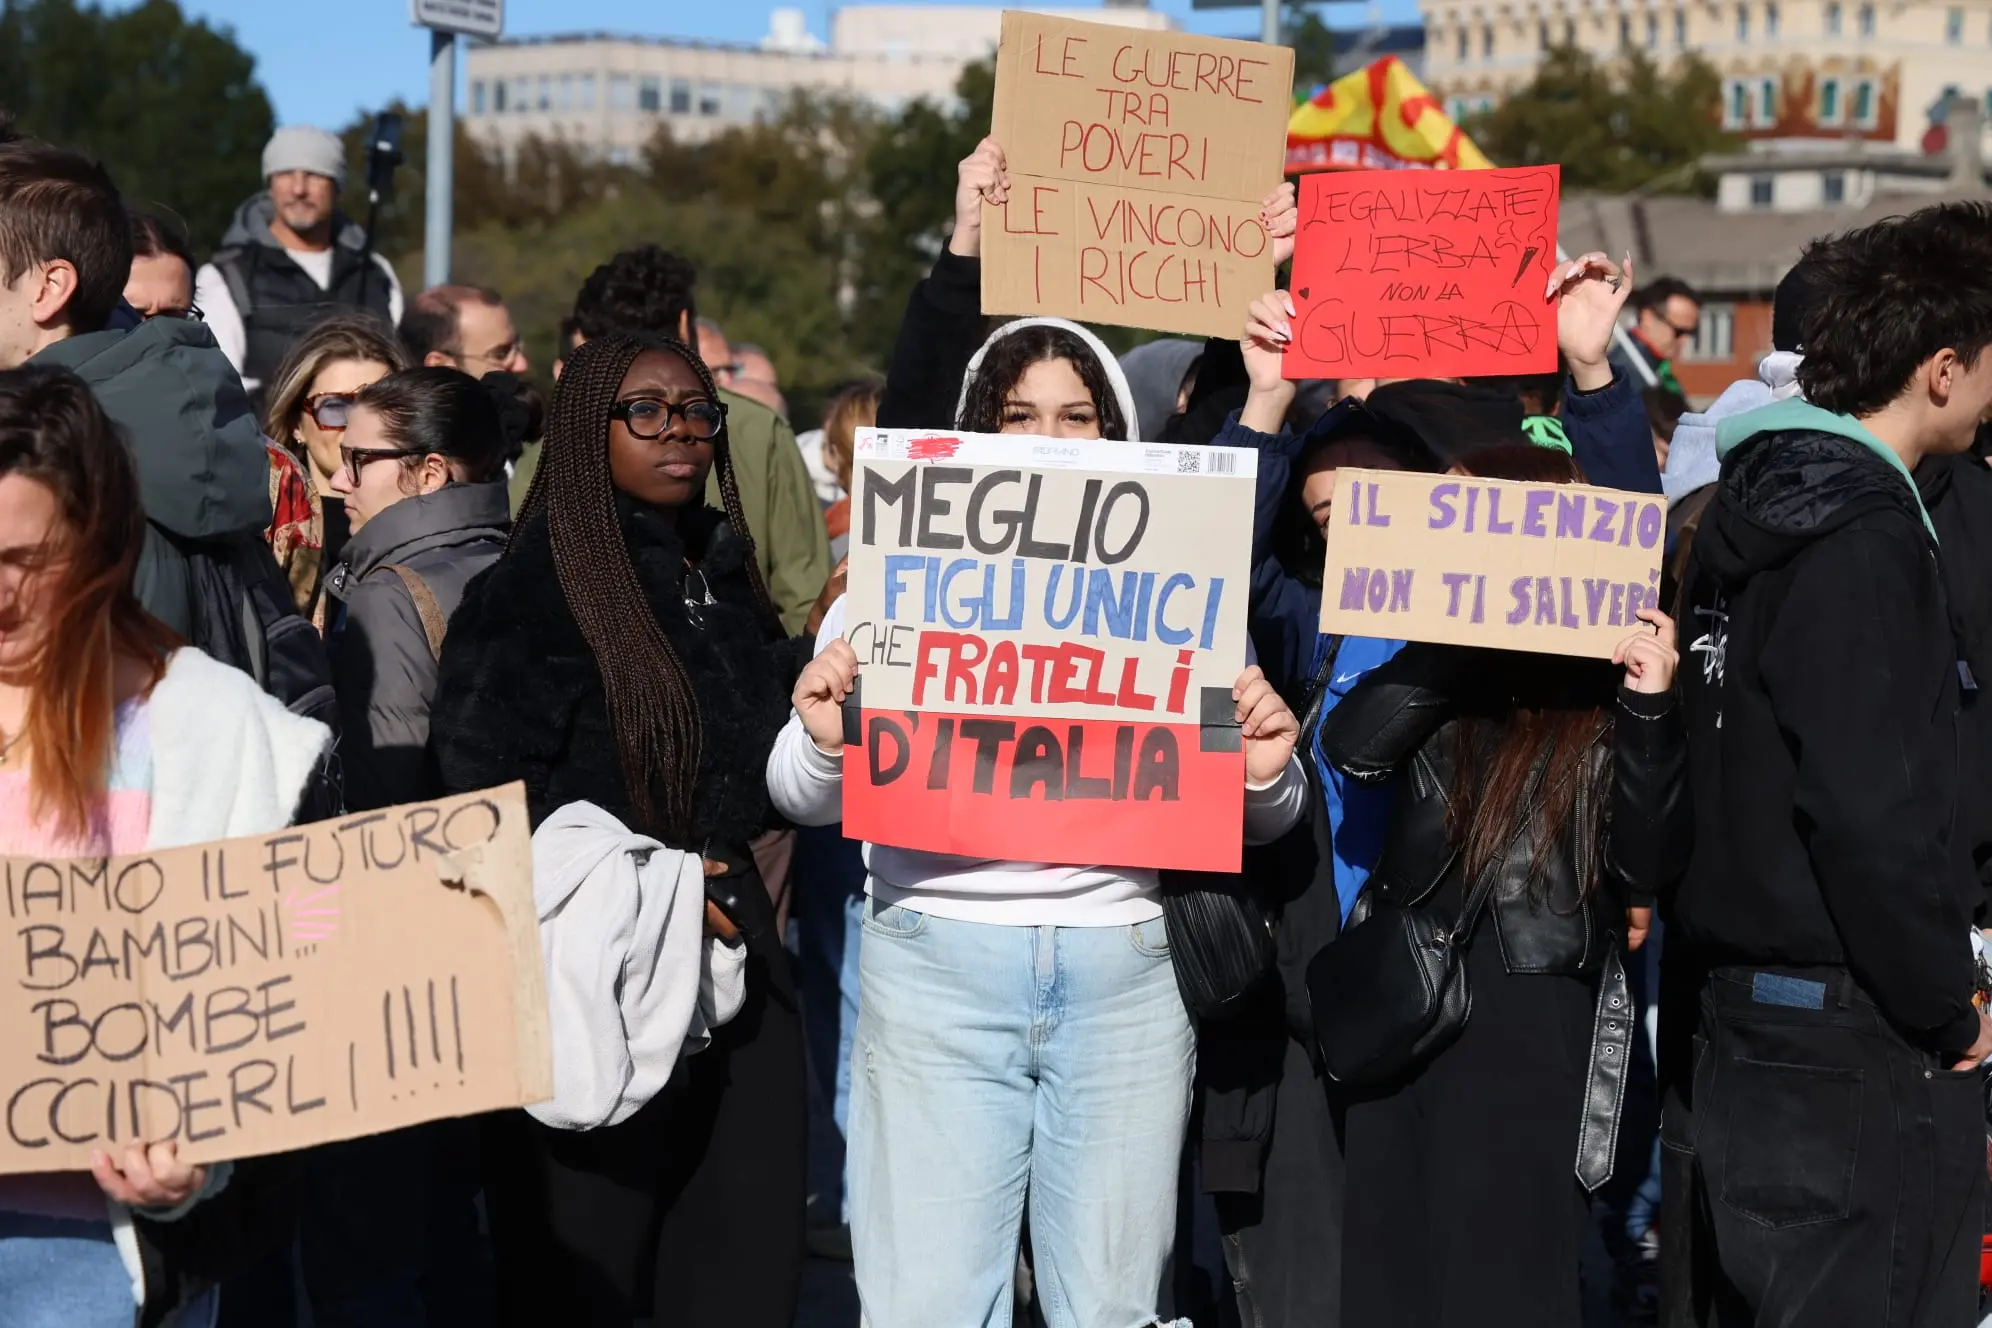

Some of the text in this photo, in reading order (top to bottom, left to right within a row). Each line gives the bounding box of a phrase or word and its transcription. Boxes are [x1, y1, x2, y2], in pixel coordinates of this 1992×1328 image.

[1036, 34, 1269, 103] LE GUERRE
[1096, 88, 1169, 127] TRA
[1060, 120, 1208, 181] POVERI
[1004, 186, 1266, 258] LE VINCONO
[1303, 183, 1545, 231] LEGALIZZATE
[1035, 245, 1221, 308] I RICCHI
[1335, 234, 1500, 274] L'ERBA
[1379, 282, 1465, 301] NON LA
[1300, 297, 1541, 365] GUERRA
[861, 464, 1150, 565] MEGLIO
[1349, 480, 1662, 550] IL SILENZIO
[1044, 563, 1225, 650] UNICI
[1339, 567, 1415, 613] NON
[1442, 572, 1487, 625] TI
[848, 621, 915, 667] CHE
[867, 711, 1180, 801] D'ITALIA
[200, 848, 249, 902] IL
[264, 798, 502, 893] FUTURO
[31, 975, 306, 1065] BOMBE
